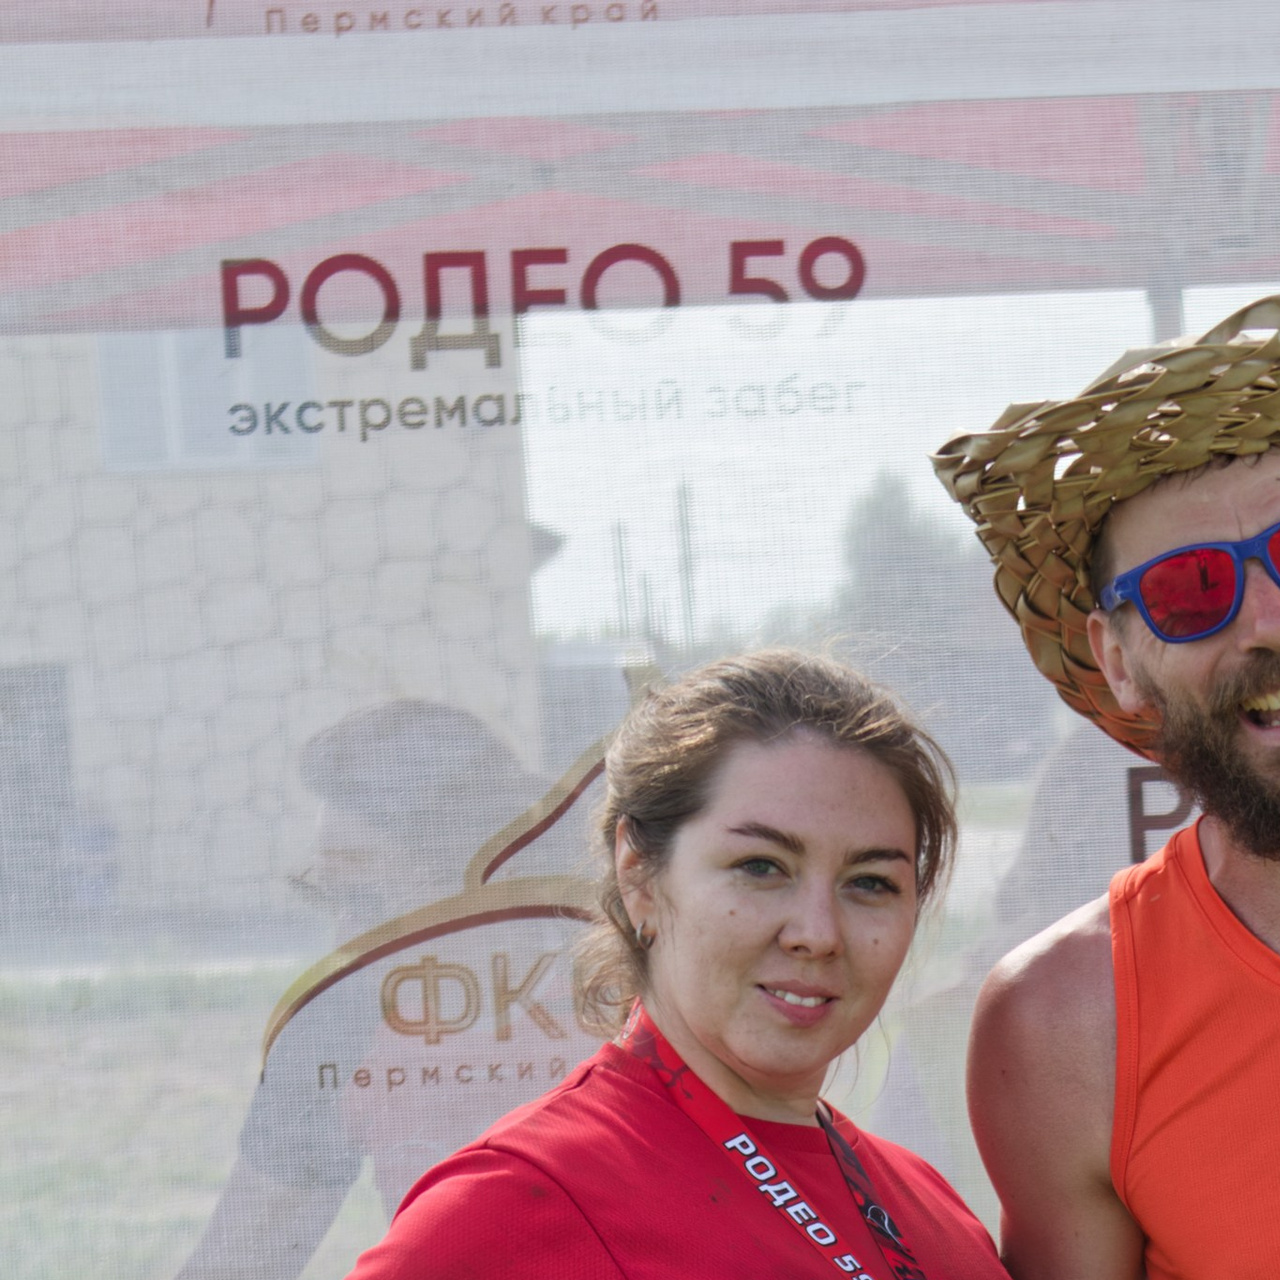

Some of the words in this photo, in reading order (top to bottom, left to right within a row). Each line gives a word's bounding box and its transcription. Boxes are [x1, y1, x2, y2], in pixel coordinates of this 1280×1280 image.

[264, 3, 517, 38] Пермский
[540, 0, 660, 30] край
[221, 243, 681, 370] РОДЕО
[729, 235, 866, 342] 59
[228, 378, 683, 443] экстремальный
[707, 372, 866, 419] забег
[317, 1056, 567, 1092] Пермский
[724, 1132, 837, 1247] РОДЕО
